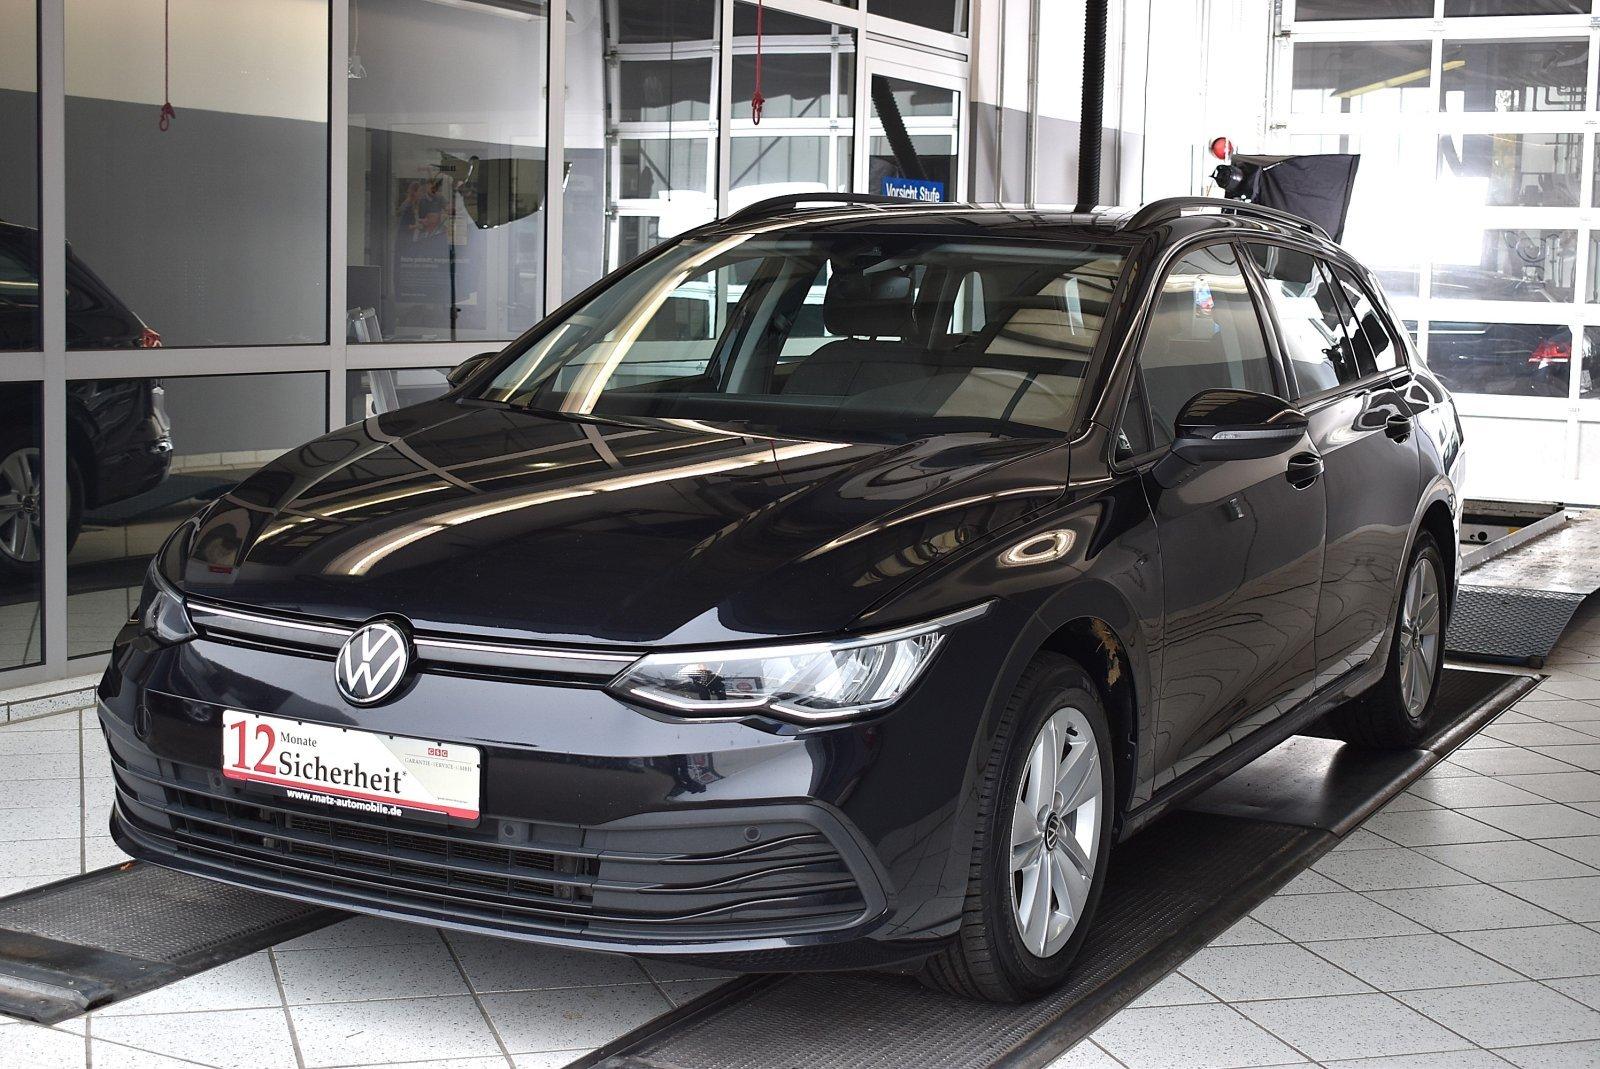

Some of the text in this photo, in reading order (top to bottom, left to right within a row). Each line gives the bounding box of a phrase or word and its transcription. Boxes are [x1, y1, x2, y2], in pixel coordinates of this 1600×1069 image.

[885, 182, 941, 203] Vorsicht Stufe
[230, 720, 277, 776] 12
[280, 731, 317, 748] Monate
[286, 789, 403, 817] www.matz-automobile.de
